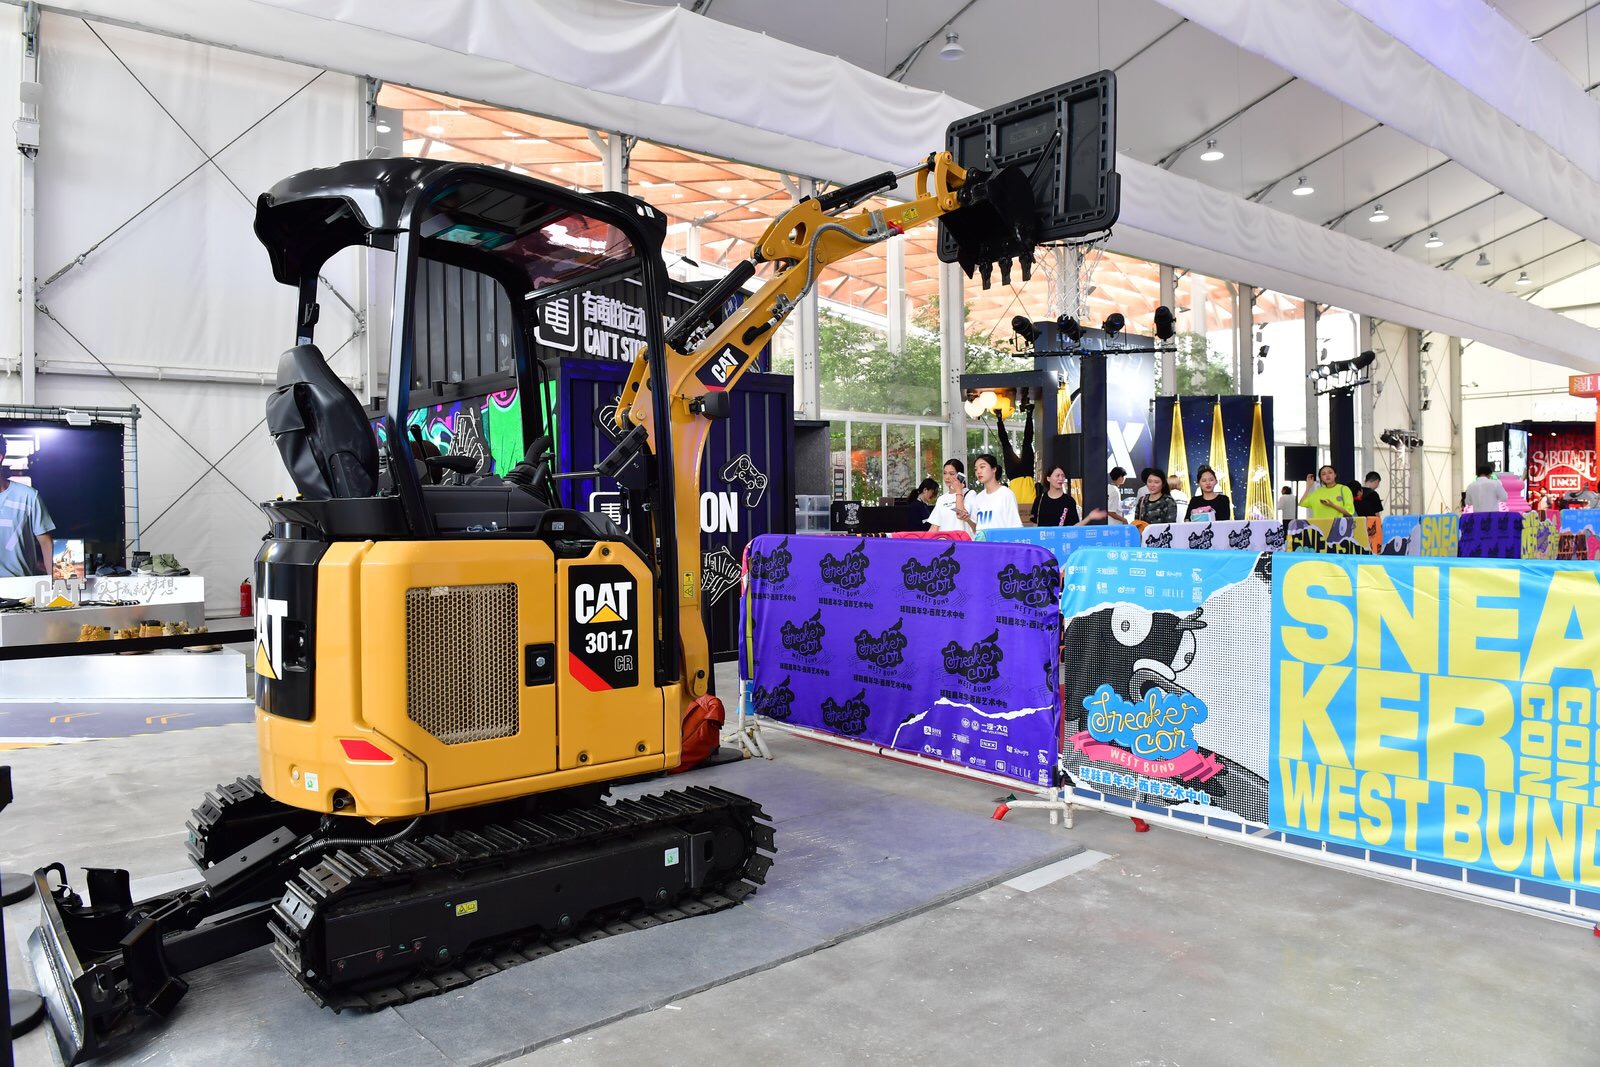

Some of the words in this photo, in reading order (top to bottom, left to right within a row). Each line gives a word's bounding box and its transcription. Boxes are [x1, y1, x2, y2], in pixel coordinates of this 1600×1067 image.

[711, 348, 739, 383] CAT
[1529, 450, 1597, 482] SABOTAGE
[35, 579, 82, 607] CAT
[575, 582, 632, 624] CAT
[256, 597, 288, 680] AT
[585, 629, 633, 654] 301.7
[1281, 560, 1600, 688] SNEA
[614, 655, 633, 672] CR
[1091, 692, 1199, 733] Sneaker
[1279, 660, 1515, 793] KER
[1135, 726, 1189, 754] con
[1520, 683, 1553, 799] CON
[1556, 686, 1591, 805] CON
[1110, 749, 1141, 768] WEST
[1143, 761, 1176, 773] BUND
[1080, 766, 1211, 805] 球鞋嘉年华·西岸艺术中心
[1279, 758, 1429, 852] WEST
